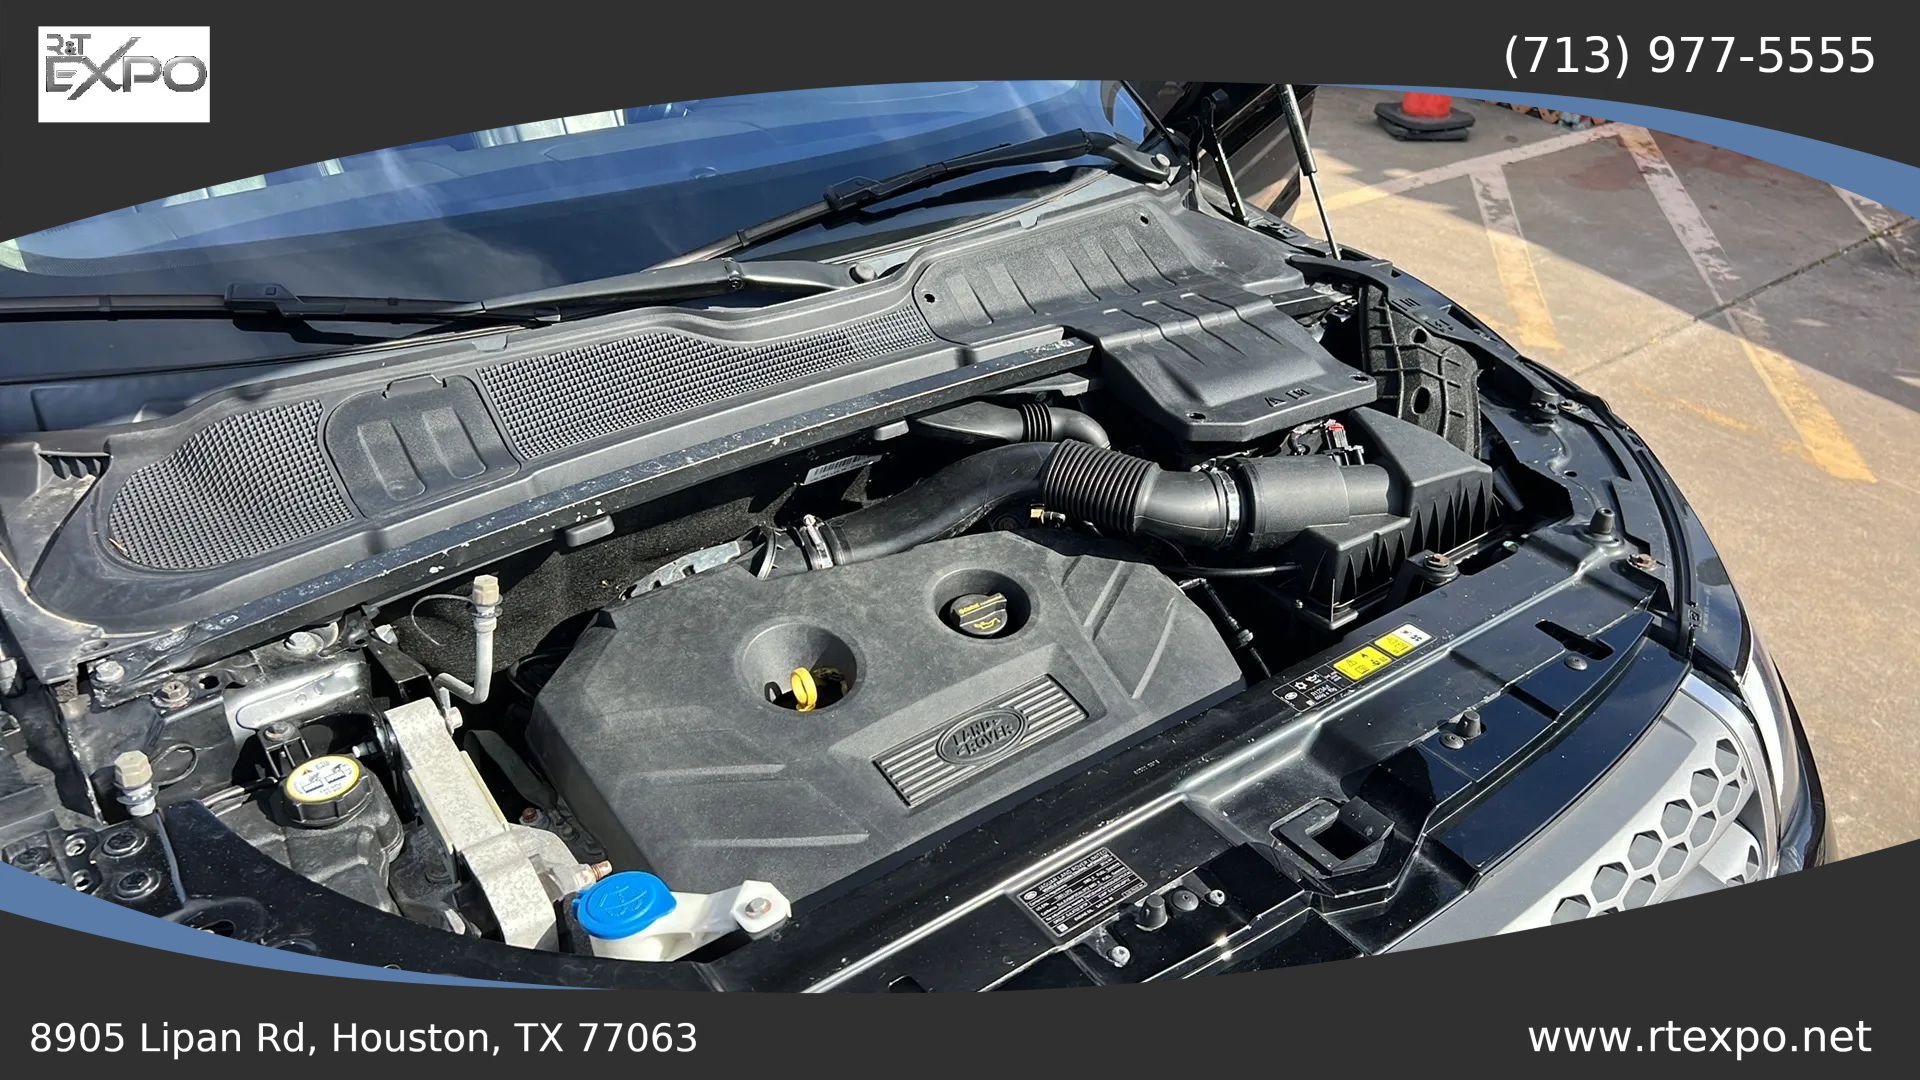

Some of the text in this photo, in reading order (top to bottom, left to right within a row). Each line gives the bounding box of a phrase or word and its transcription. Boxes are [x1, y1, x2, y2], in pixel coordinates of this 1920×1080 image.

[953, 718, 995, 746] LAND
[967, 725, 1015, 756] ROVER
[1037, 877, 1059, 890] JAGUAR
[1057, 869, 1073, 879] LAND
[1071, 860, 1089, 871] ROVER
[1087, 850, 1108, 862] LIMITED
